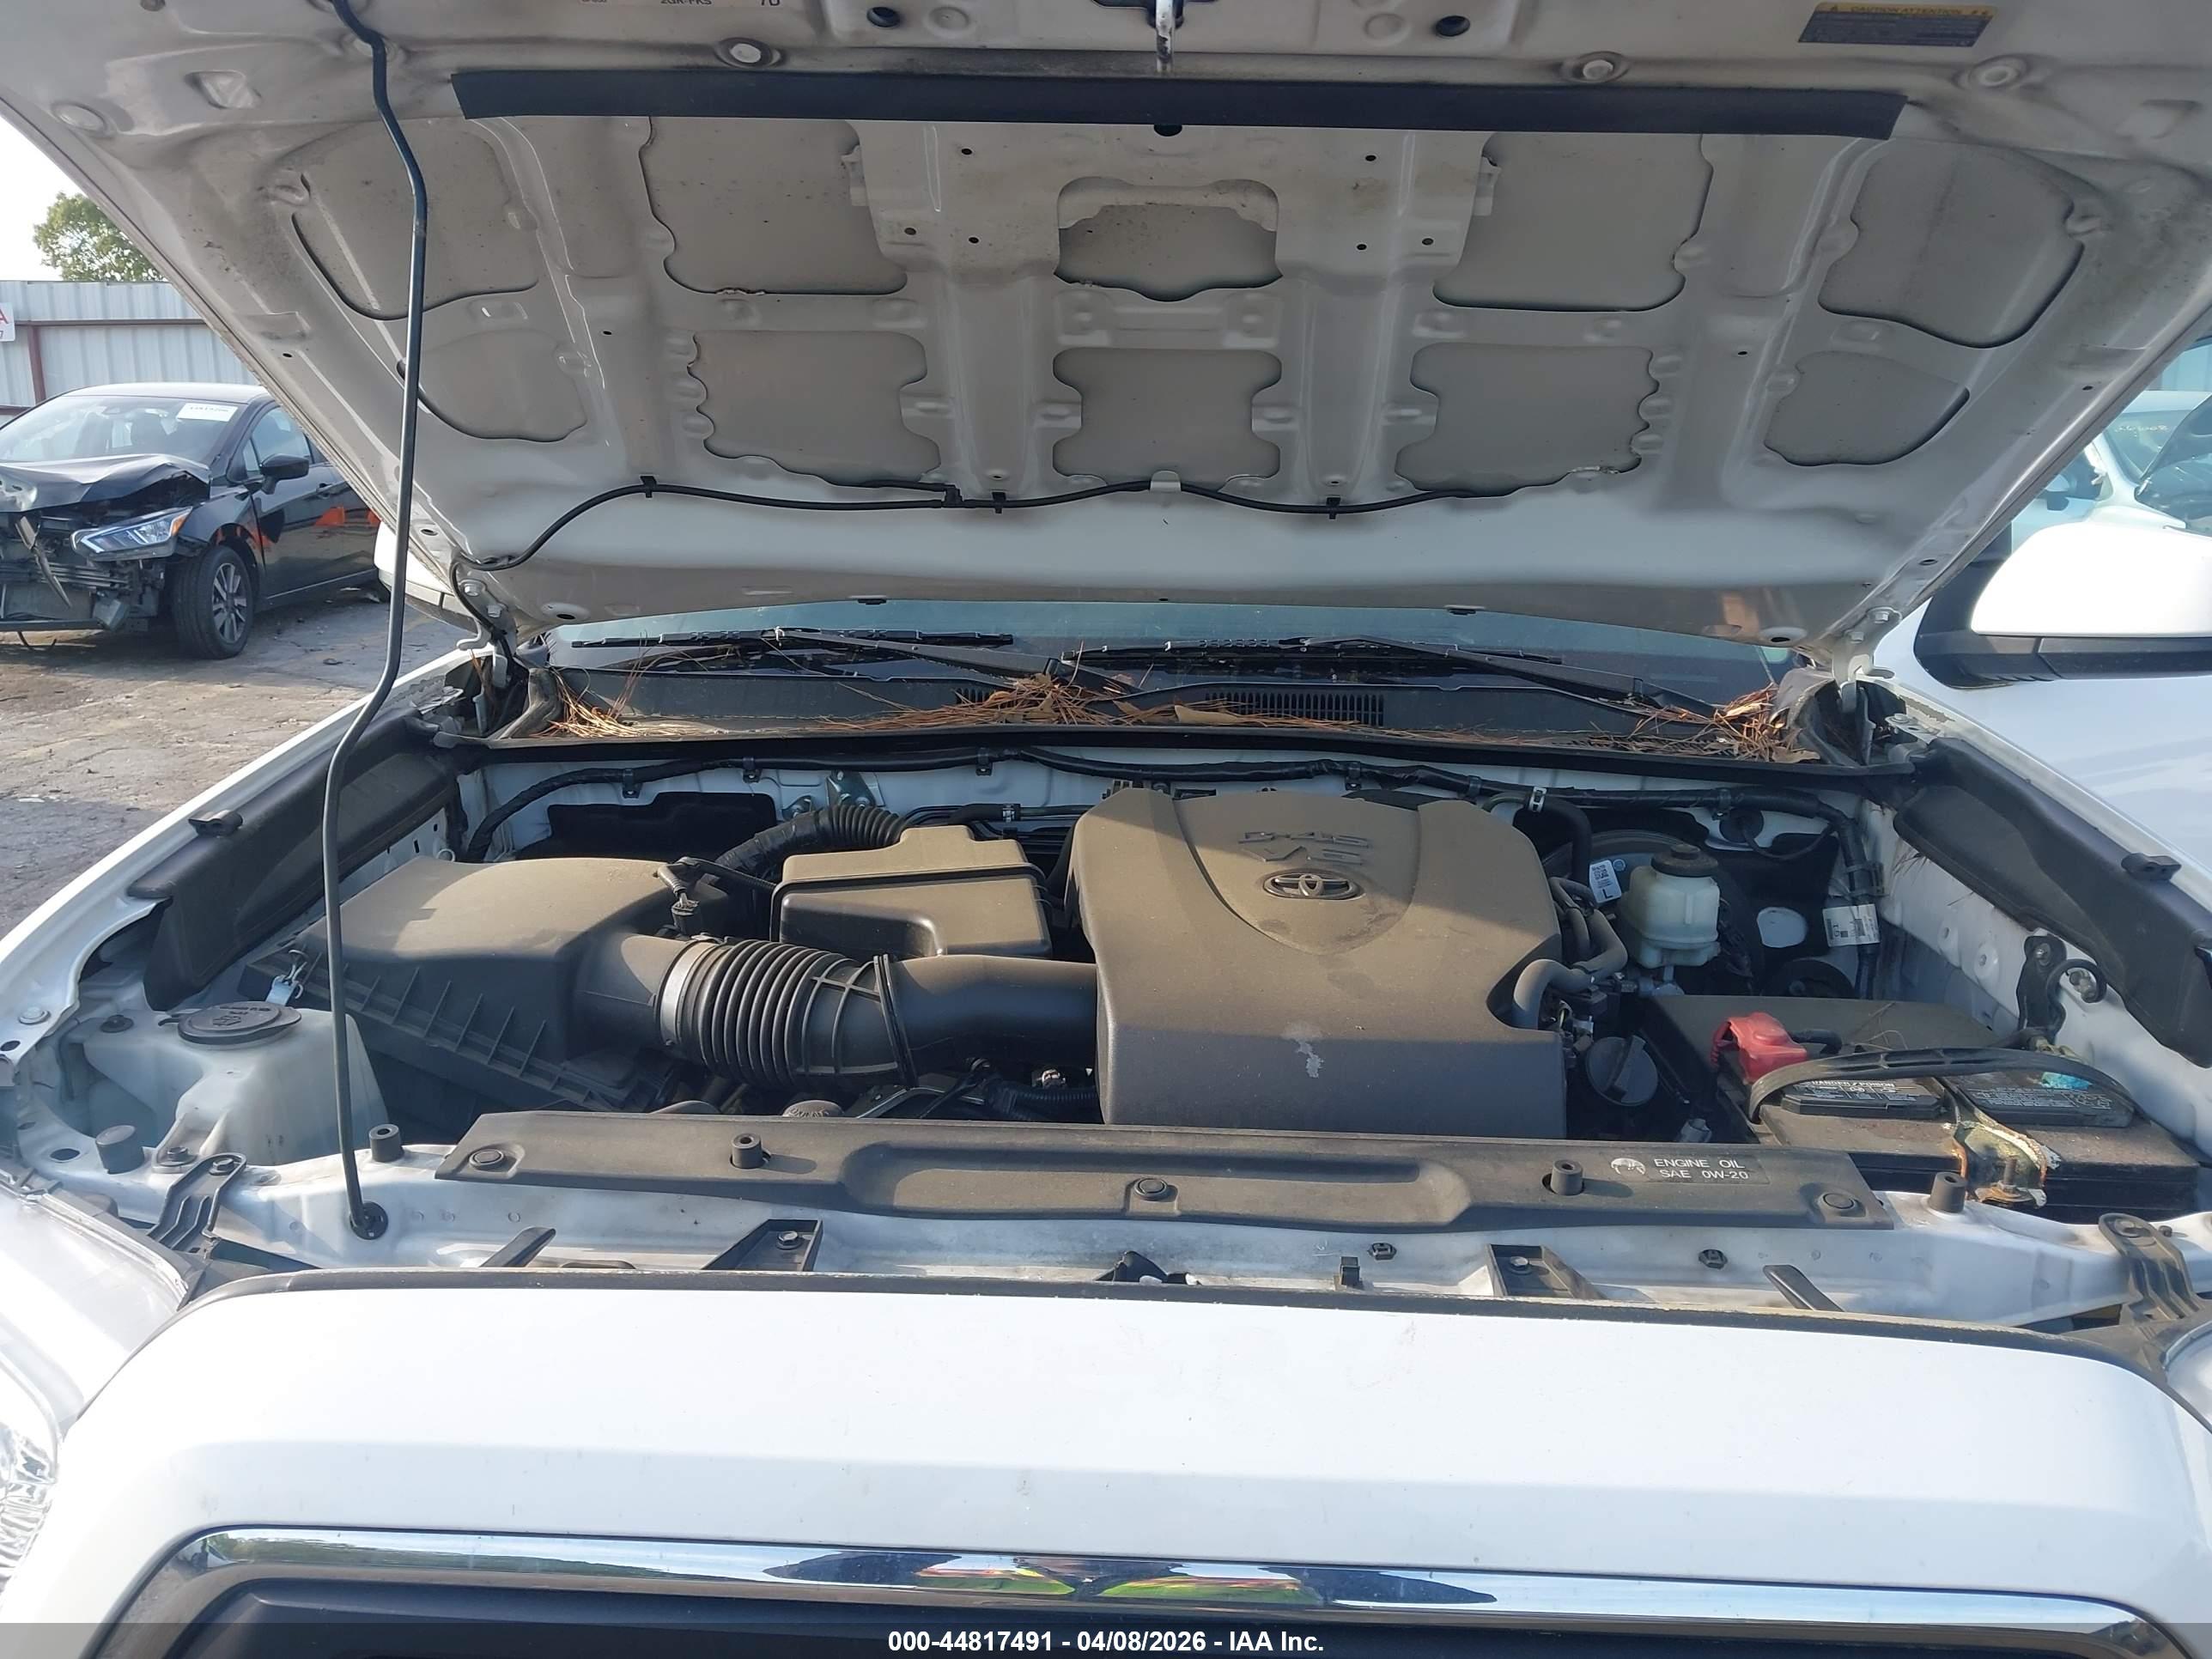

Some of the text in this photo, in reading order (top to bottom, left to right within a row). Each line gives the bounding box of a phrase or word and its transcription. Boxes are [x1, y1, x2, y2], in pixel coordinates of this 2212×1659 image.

[1602, 888, 1613, 899] L
[1654, 1158, 1745, 1169] ENGINE OIL
[1659, 1169, 1749, 1180] SAE 0W-20
